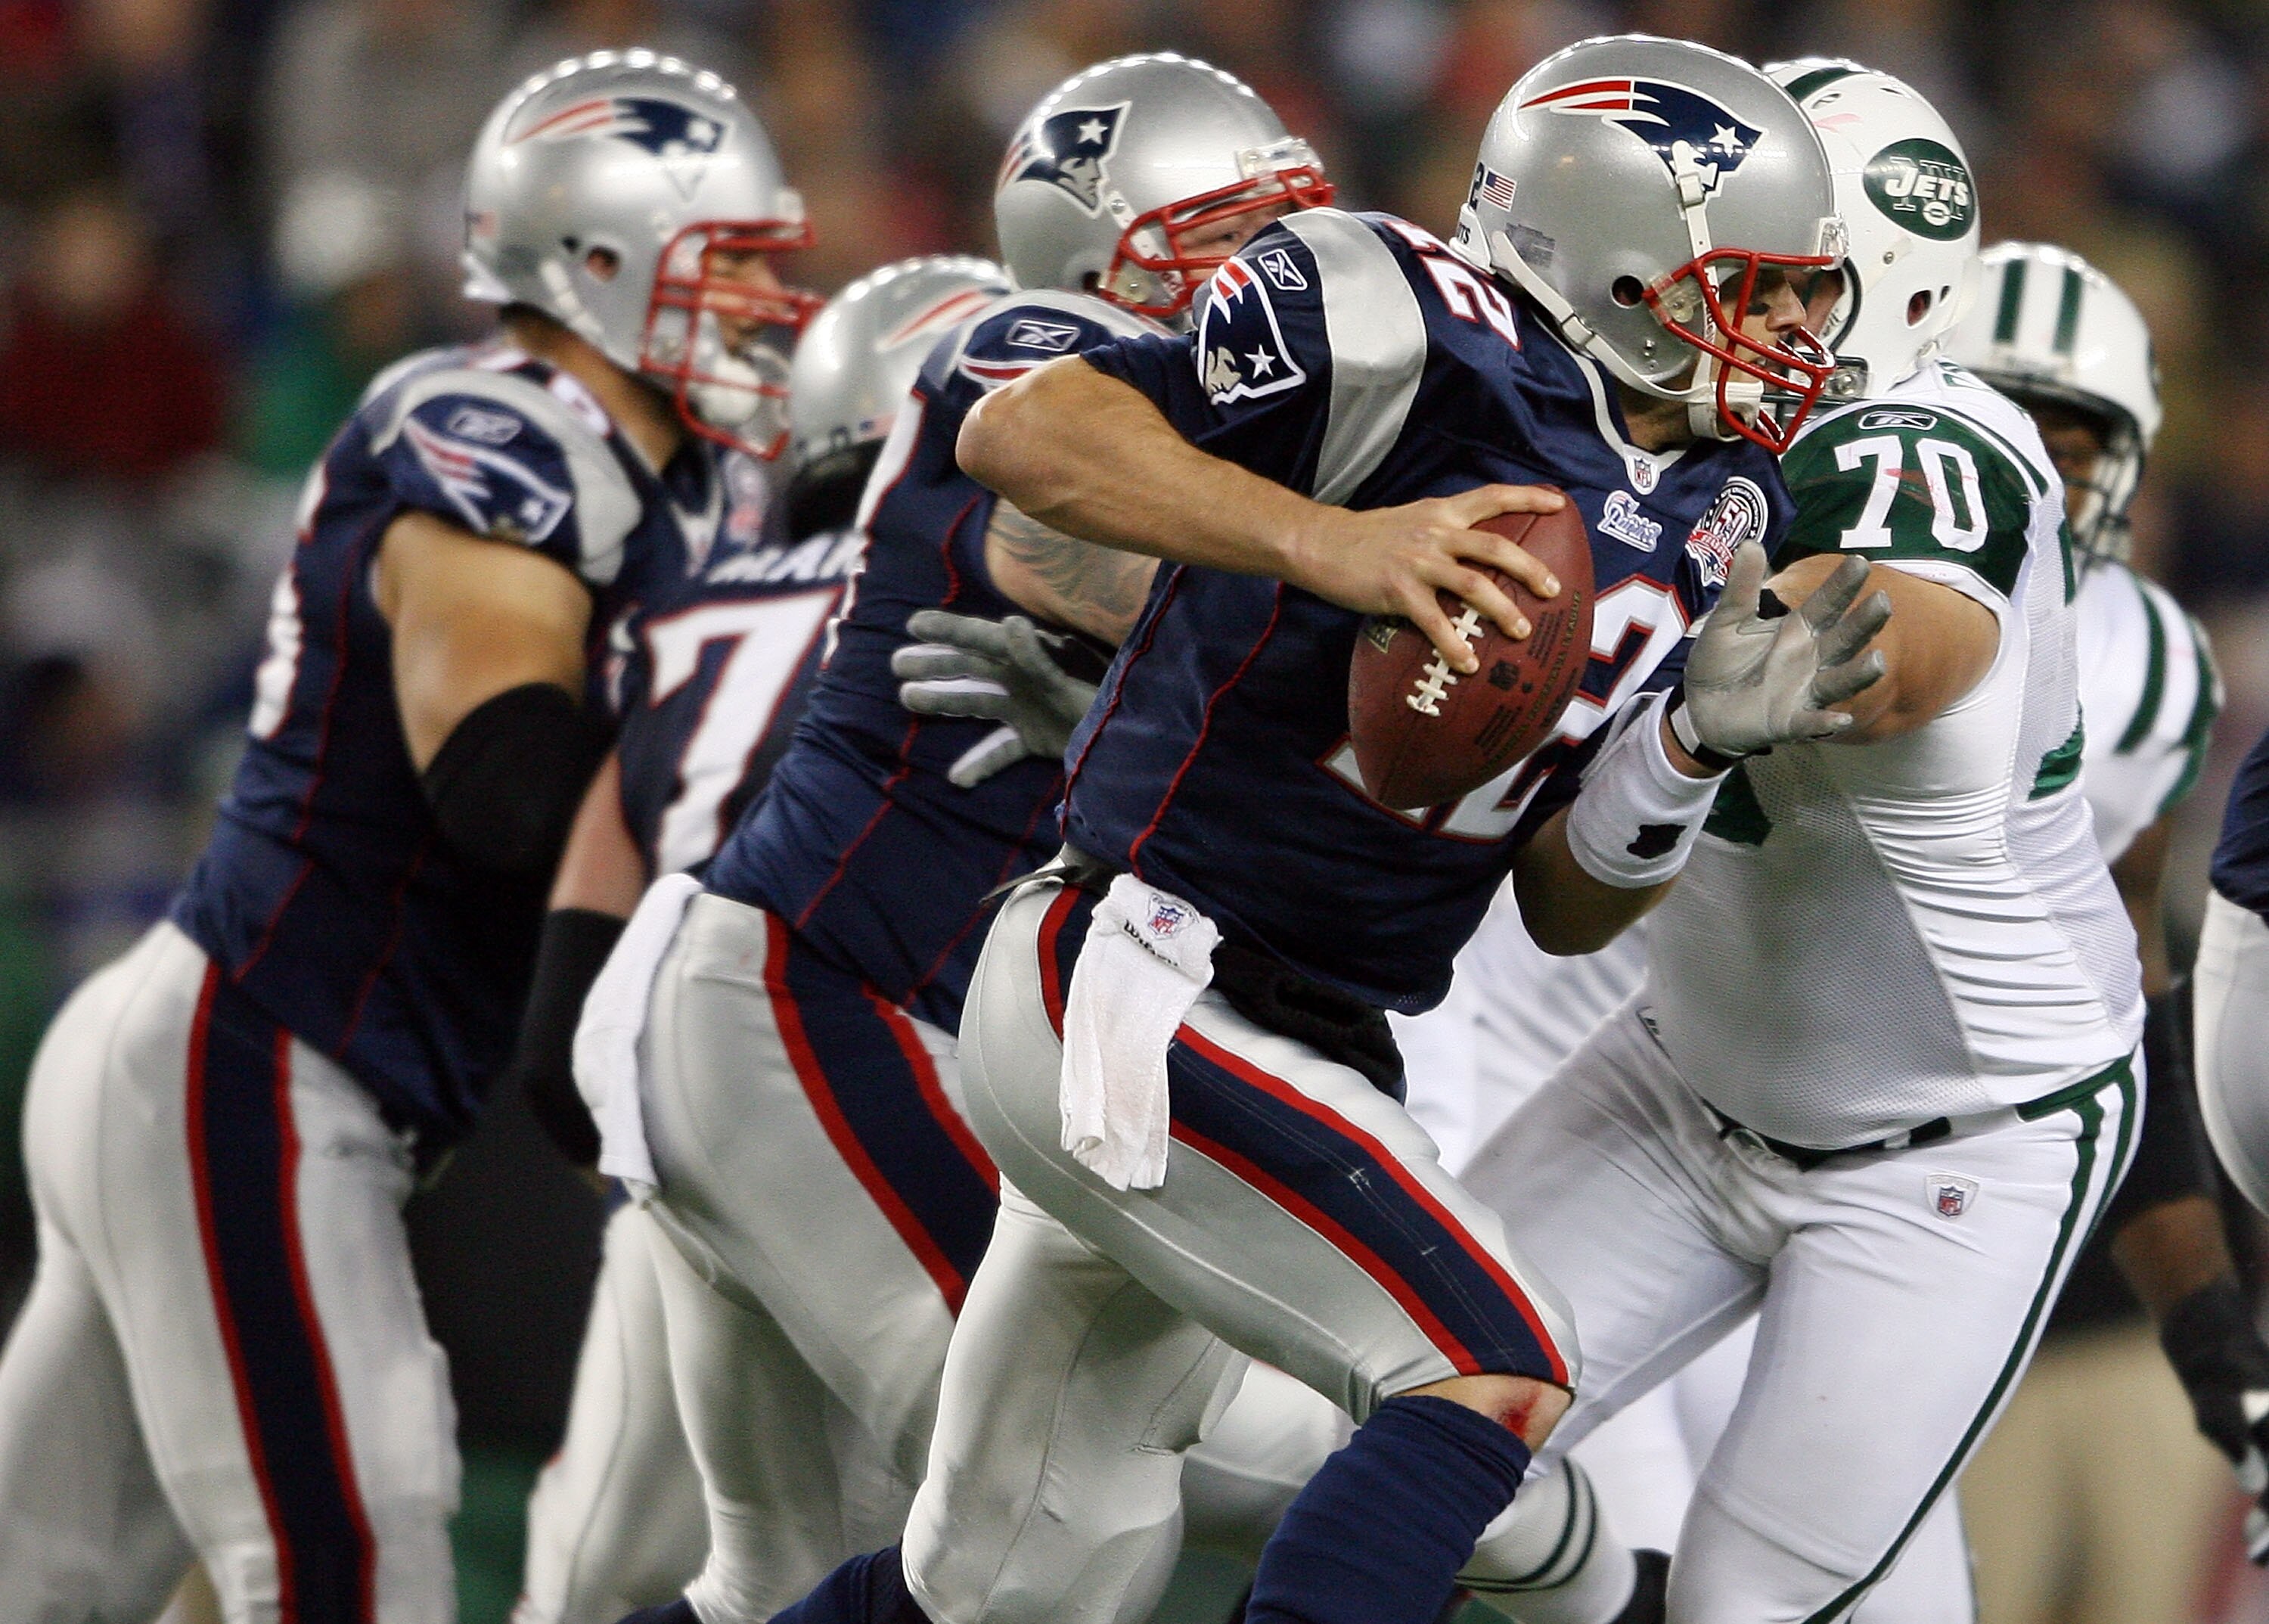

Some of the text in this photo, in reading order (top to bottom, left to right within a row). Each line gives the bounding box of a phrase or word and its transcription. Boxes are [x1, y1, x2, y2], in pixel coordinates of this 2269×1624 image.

[1884, 165, 1969, 206] JETS
[1834, 434, 1988, 554] 70
[643, 583, 846, 876] 7
